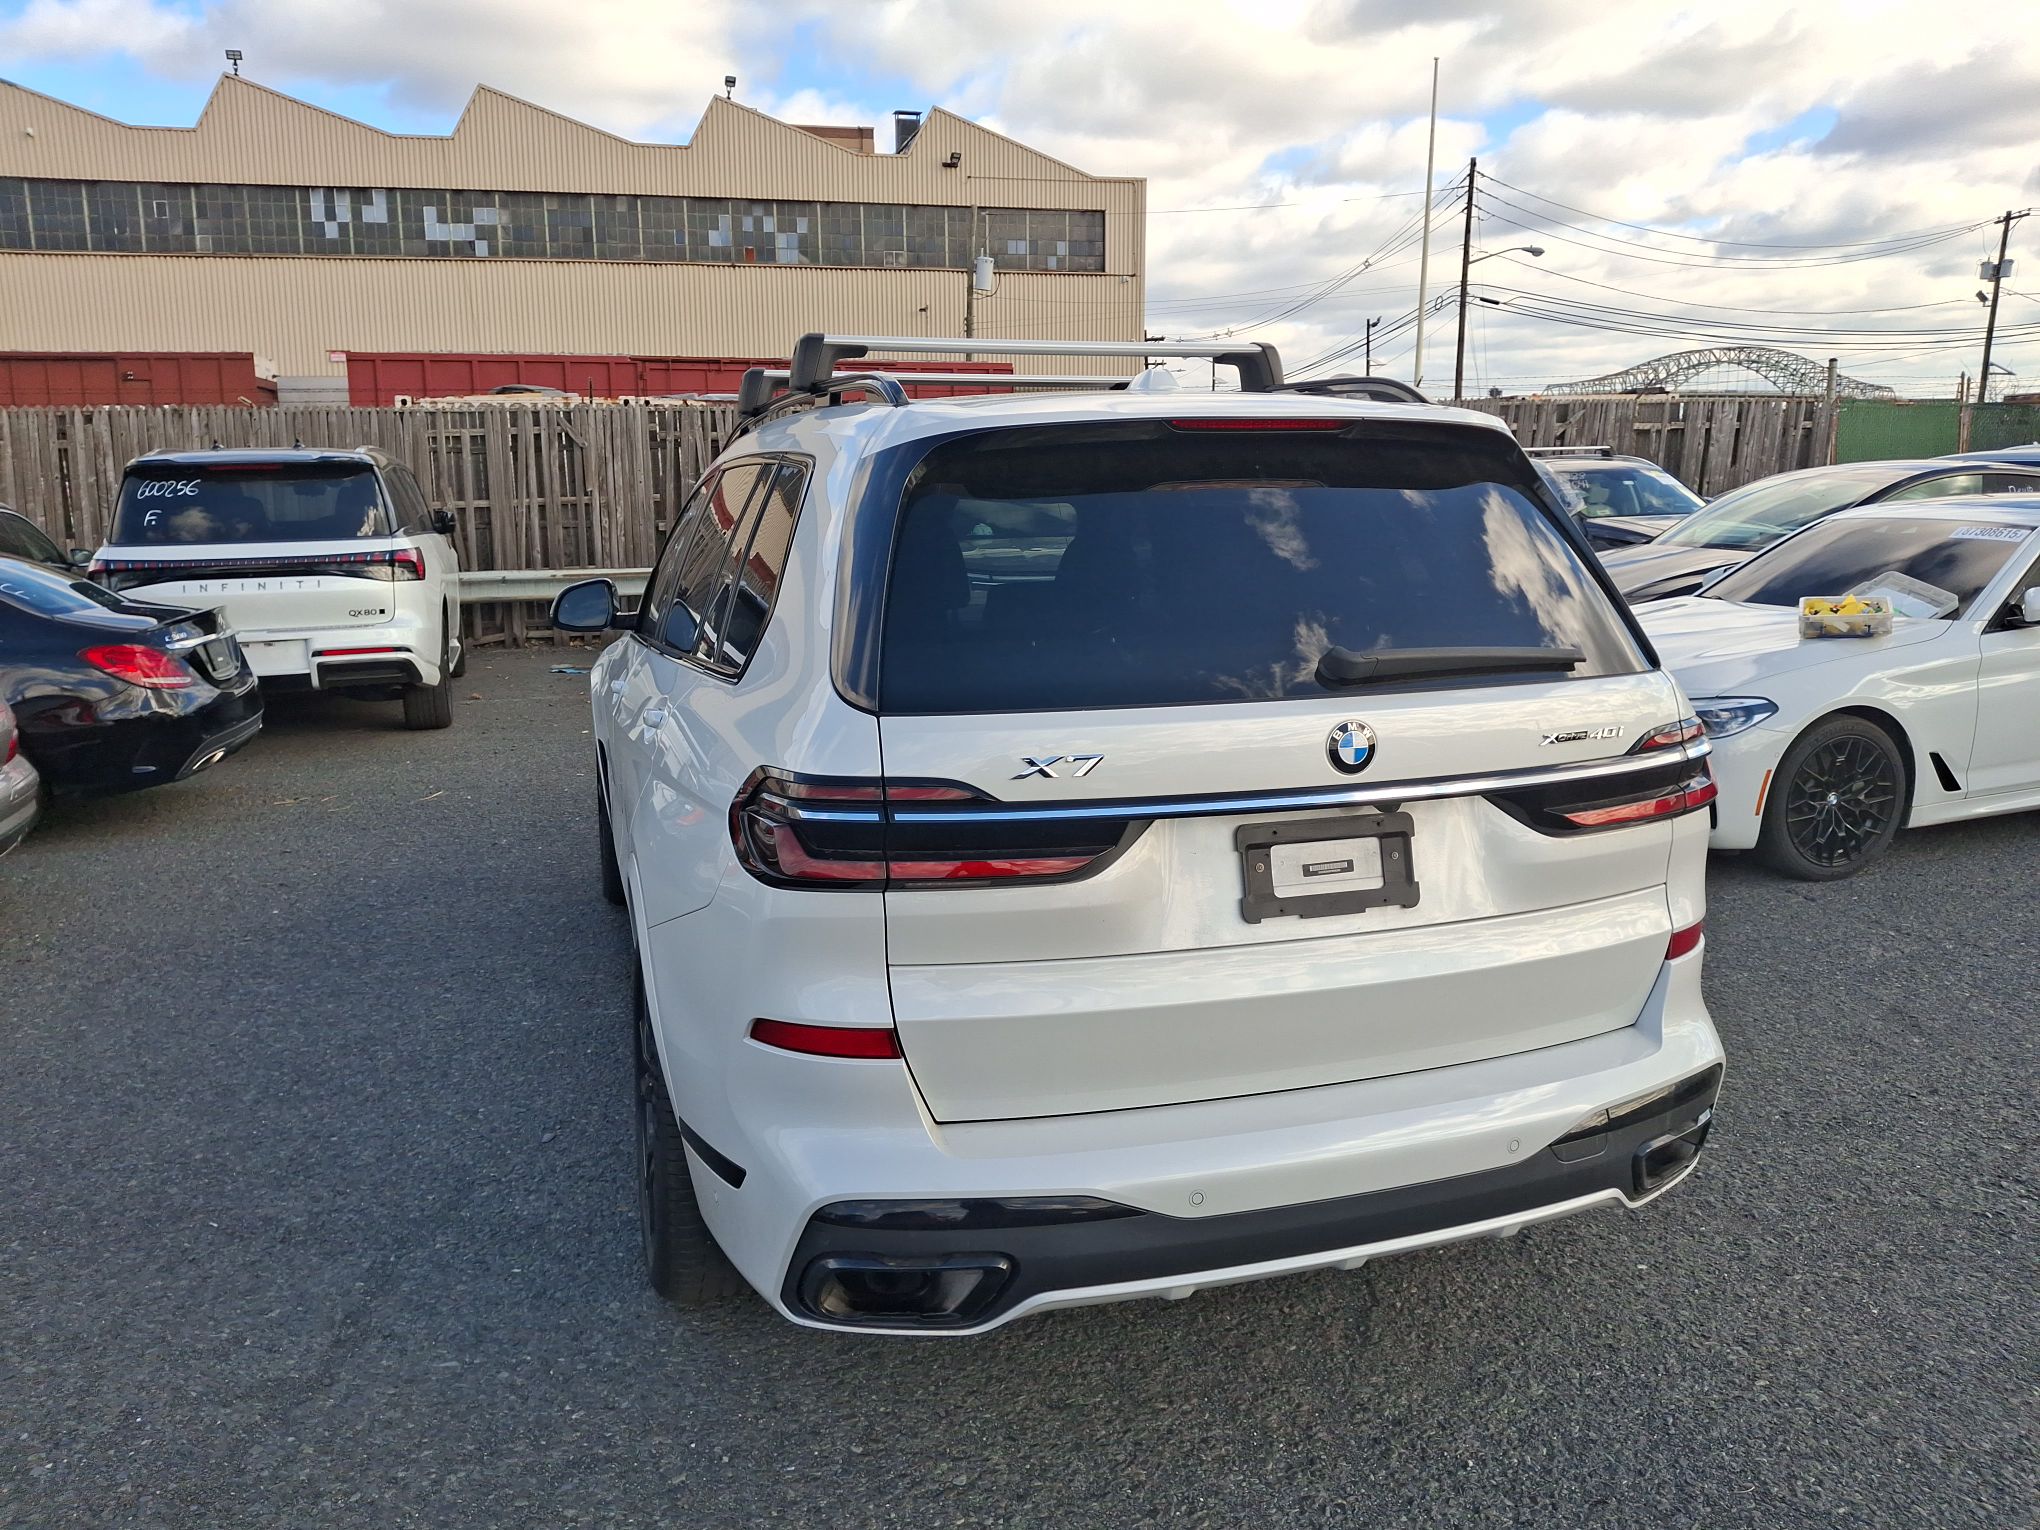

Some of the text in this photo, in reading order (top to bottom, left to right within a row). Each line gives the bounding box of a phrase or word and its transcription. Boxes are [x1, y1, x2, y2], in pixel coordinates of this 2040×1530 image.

[137, 479, 201, 499] 600256
[182, 580, 321, 593] INFINITI
[348, 608, 378, 618] QX80
[1332, 722, 1373, 741] BMW
[1008, 753, 1104, 780] X7
